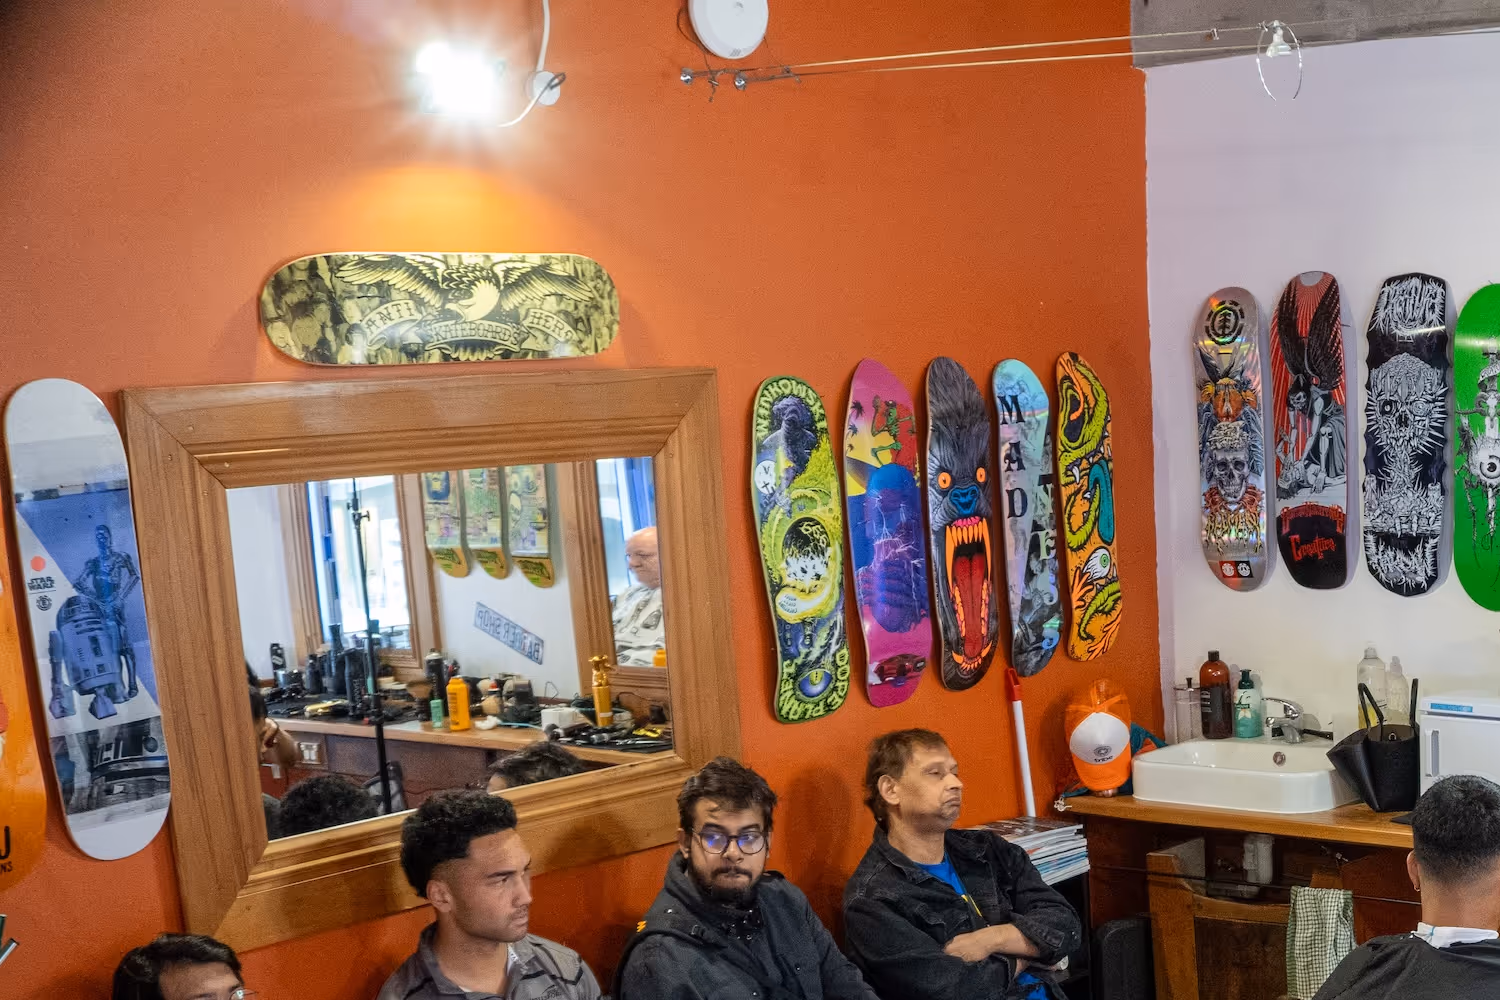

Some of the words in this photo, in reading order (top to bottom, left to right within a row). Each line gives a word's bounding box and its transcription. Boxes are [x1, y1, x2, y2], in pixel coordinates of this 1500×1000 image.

[366, 302, 416, 334] ANTI
[431, 320, 523, 347] SKATEBOARDS
[530, 310, 575, 341] HERO
